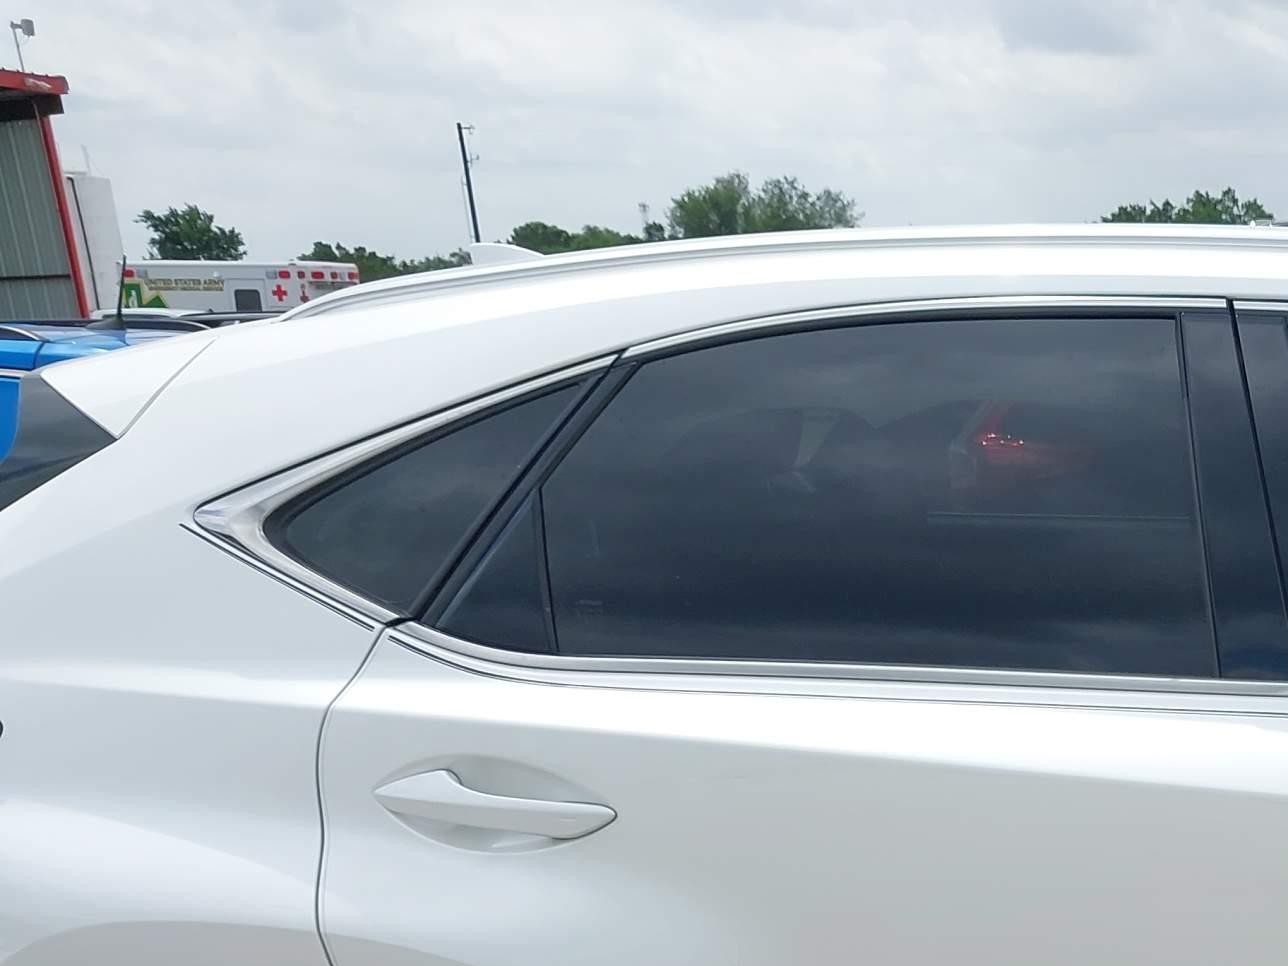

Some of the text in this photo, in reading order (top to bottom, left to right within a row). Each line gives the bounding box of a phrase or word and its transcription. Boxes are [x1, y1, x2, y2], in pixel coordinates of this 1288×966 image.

[144, 278, 225, 286] UNITED STATES ARMY
